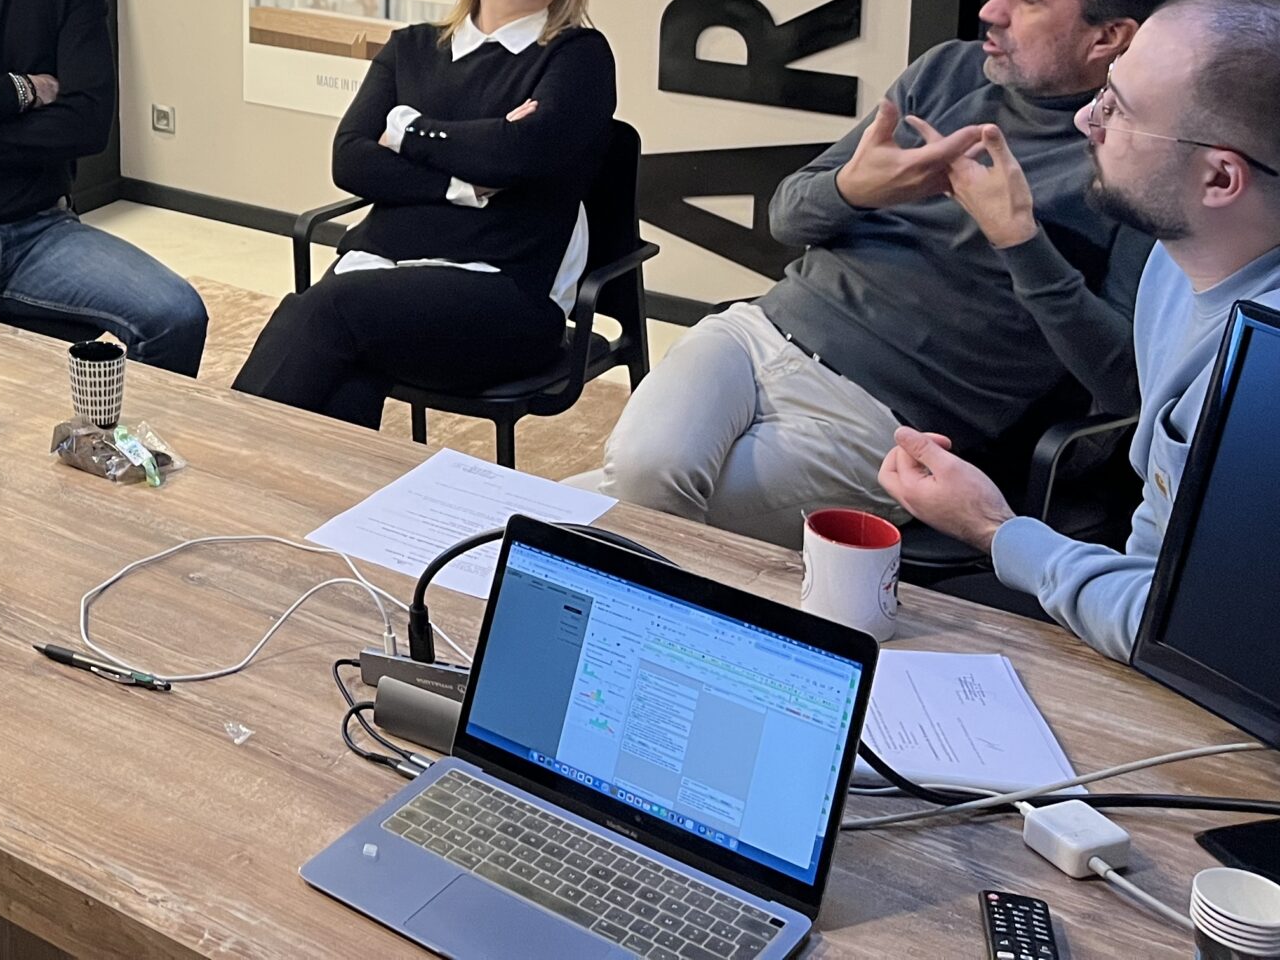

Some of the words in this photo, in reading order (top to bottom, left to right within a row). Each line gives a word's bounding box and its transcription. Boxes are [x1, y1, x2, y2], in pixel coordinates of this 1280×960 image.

[316, 74, 339, 89] MADE
[340, 78, 350, 90] IN
[351, 79, 362, 91] IT
